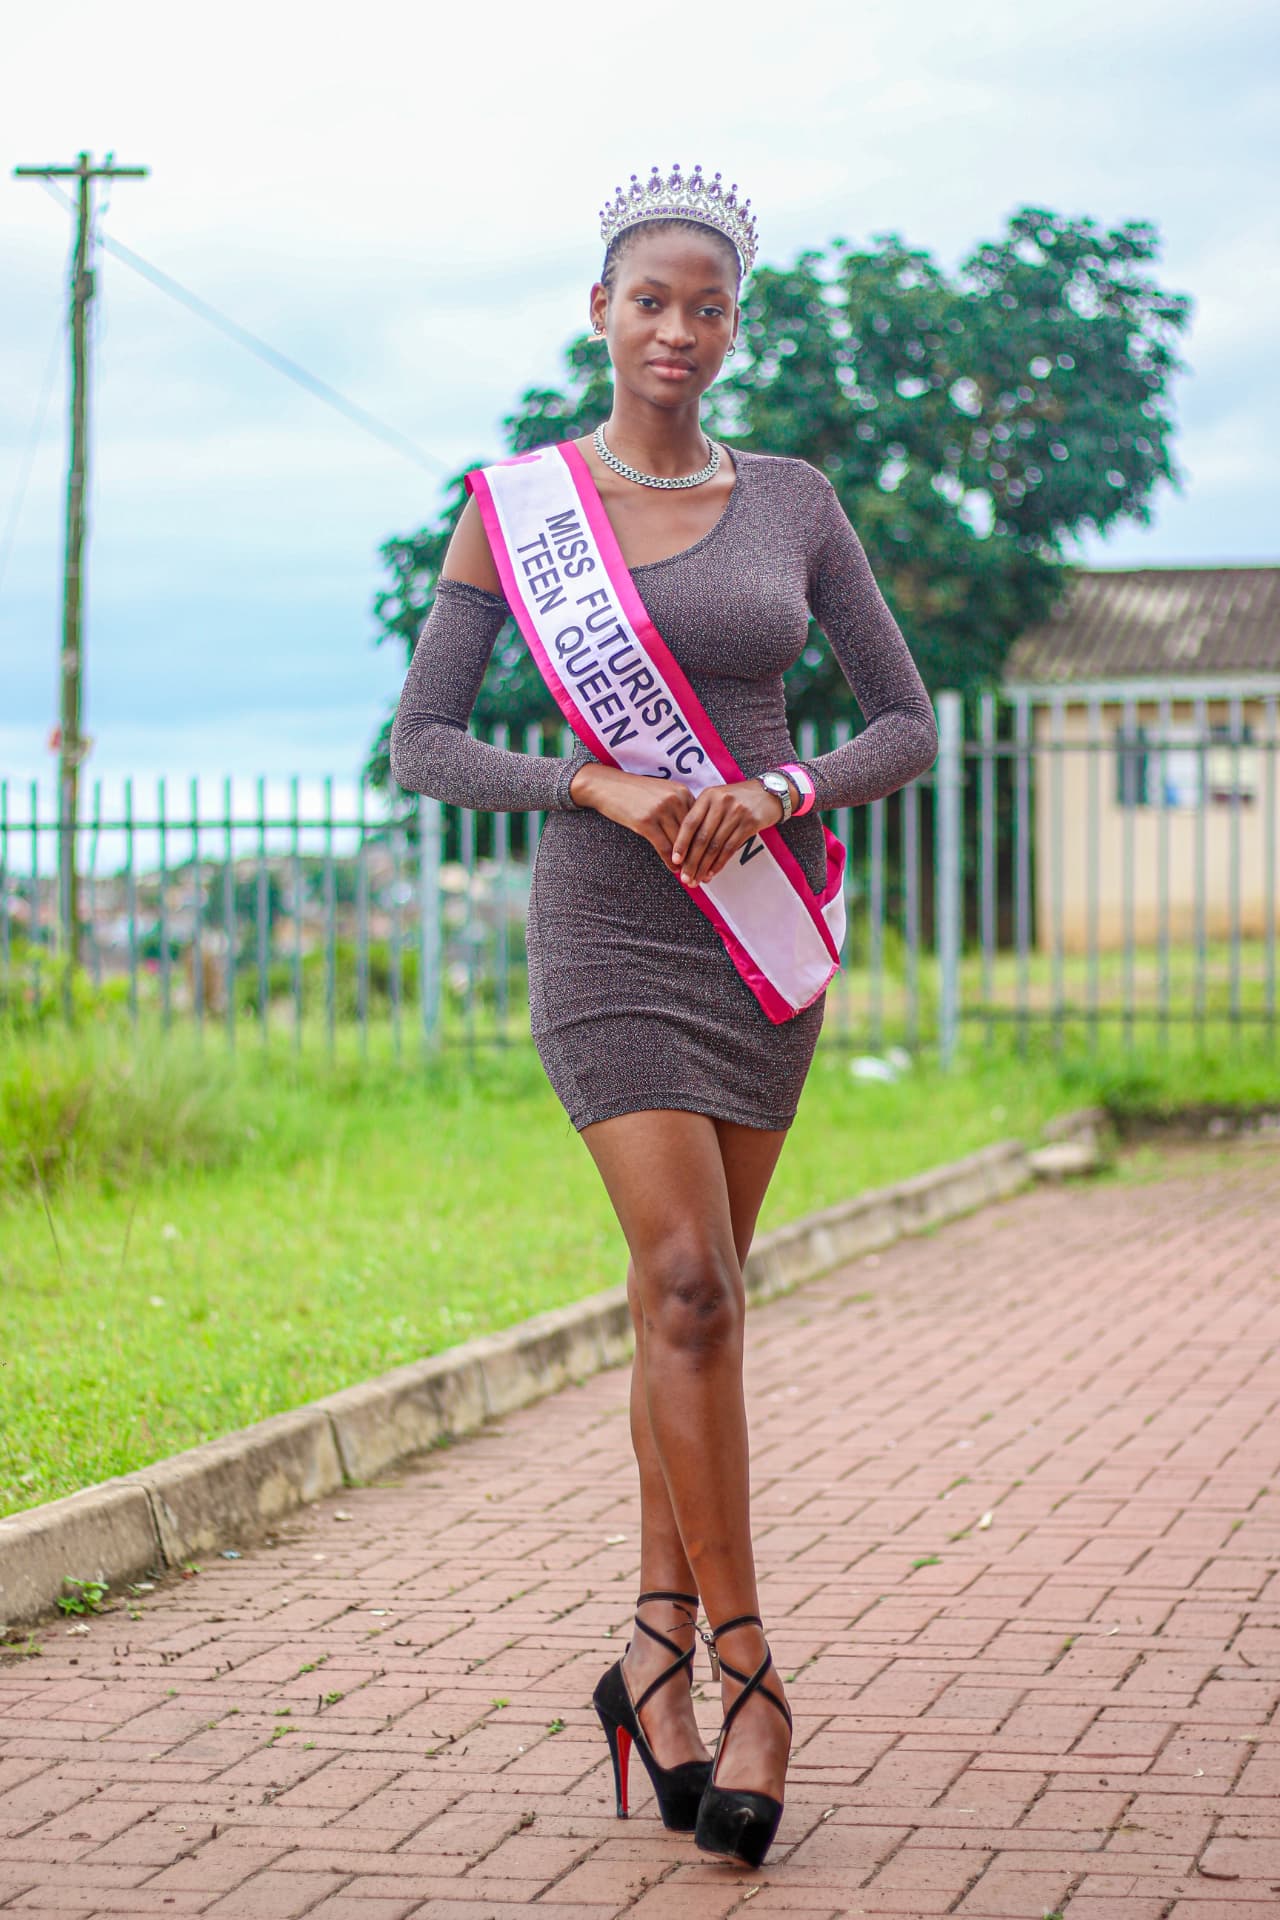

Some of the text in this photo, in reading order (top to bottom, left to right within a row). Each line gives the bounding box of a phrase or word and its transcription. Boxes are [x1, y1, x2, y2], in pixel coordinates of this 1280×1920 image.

[517, 532, 639, 750] TEEN QUEEN
[544, 508, 705, 775] MISS FUTURISTIC
